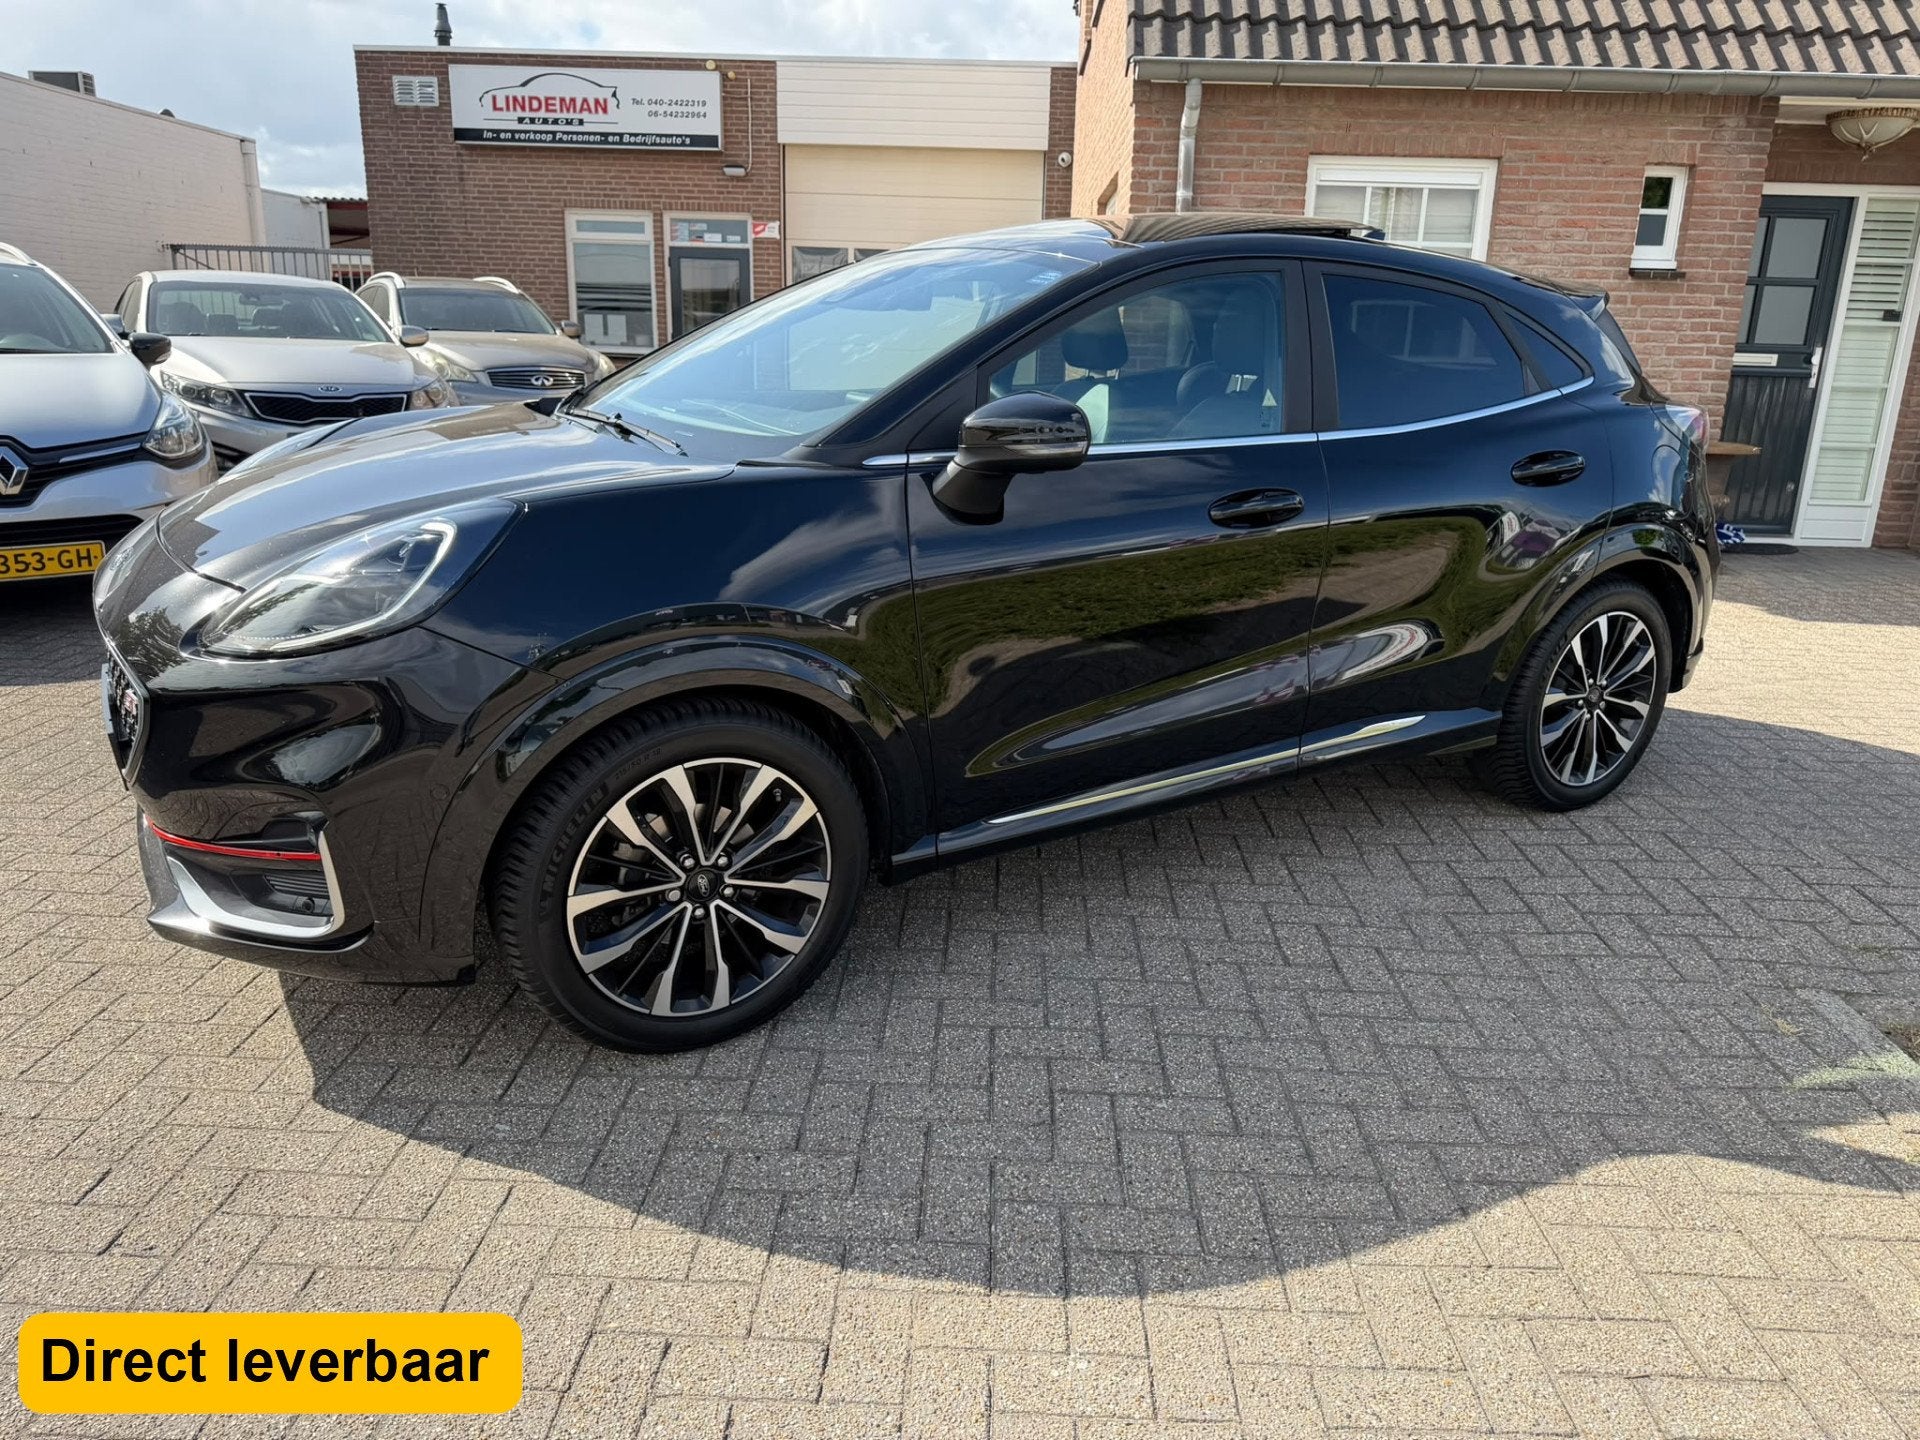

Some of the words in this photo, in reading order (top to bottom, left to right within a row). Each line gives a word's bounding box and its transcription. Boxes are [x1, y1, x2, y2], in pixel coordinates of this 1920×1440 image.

[491, 94, 608, 115] LINDEMAN
[631, 97, 645, 106] Tel.
[647, 98, 707, 108] 040-2422319
[647, 110, 707, 119] 06-54232964
[483, 130, 497, 139] In-
[500, 132, 512, 140] en
[514, 131, 553, 143] verkoop
[555, 132, 606, 143] Personen-
[608, 135, 620, 143] en
[622, 133, 691, 146] Bedrijfsauto's
[542, 786, 605, 892] MICHELIN
